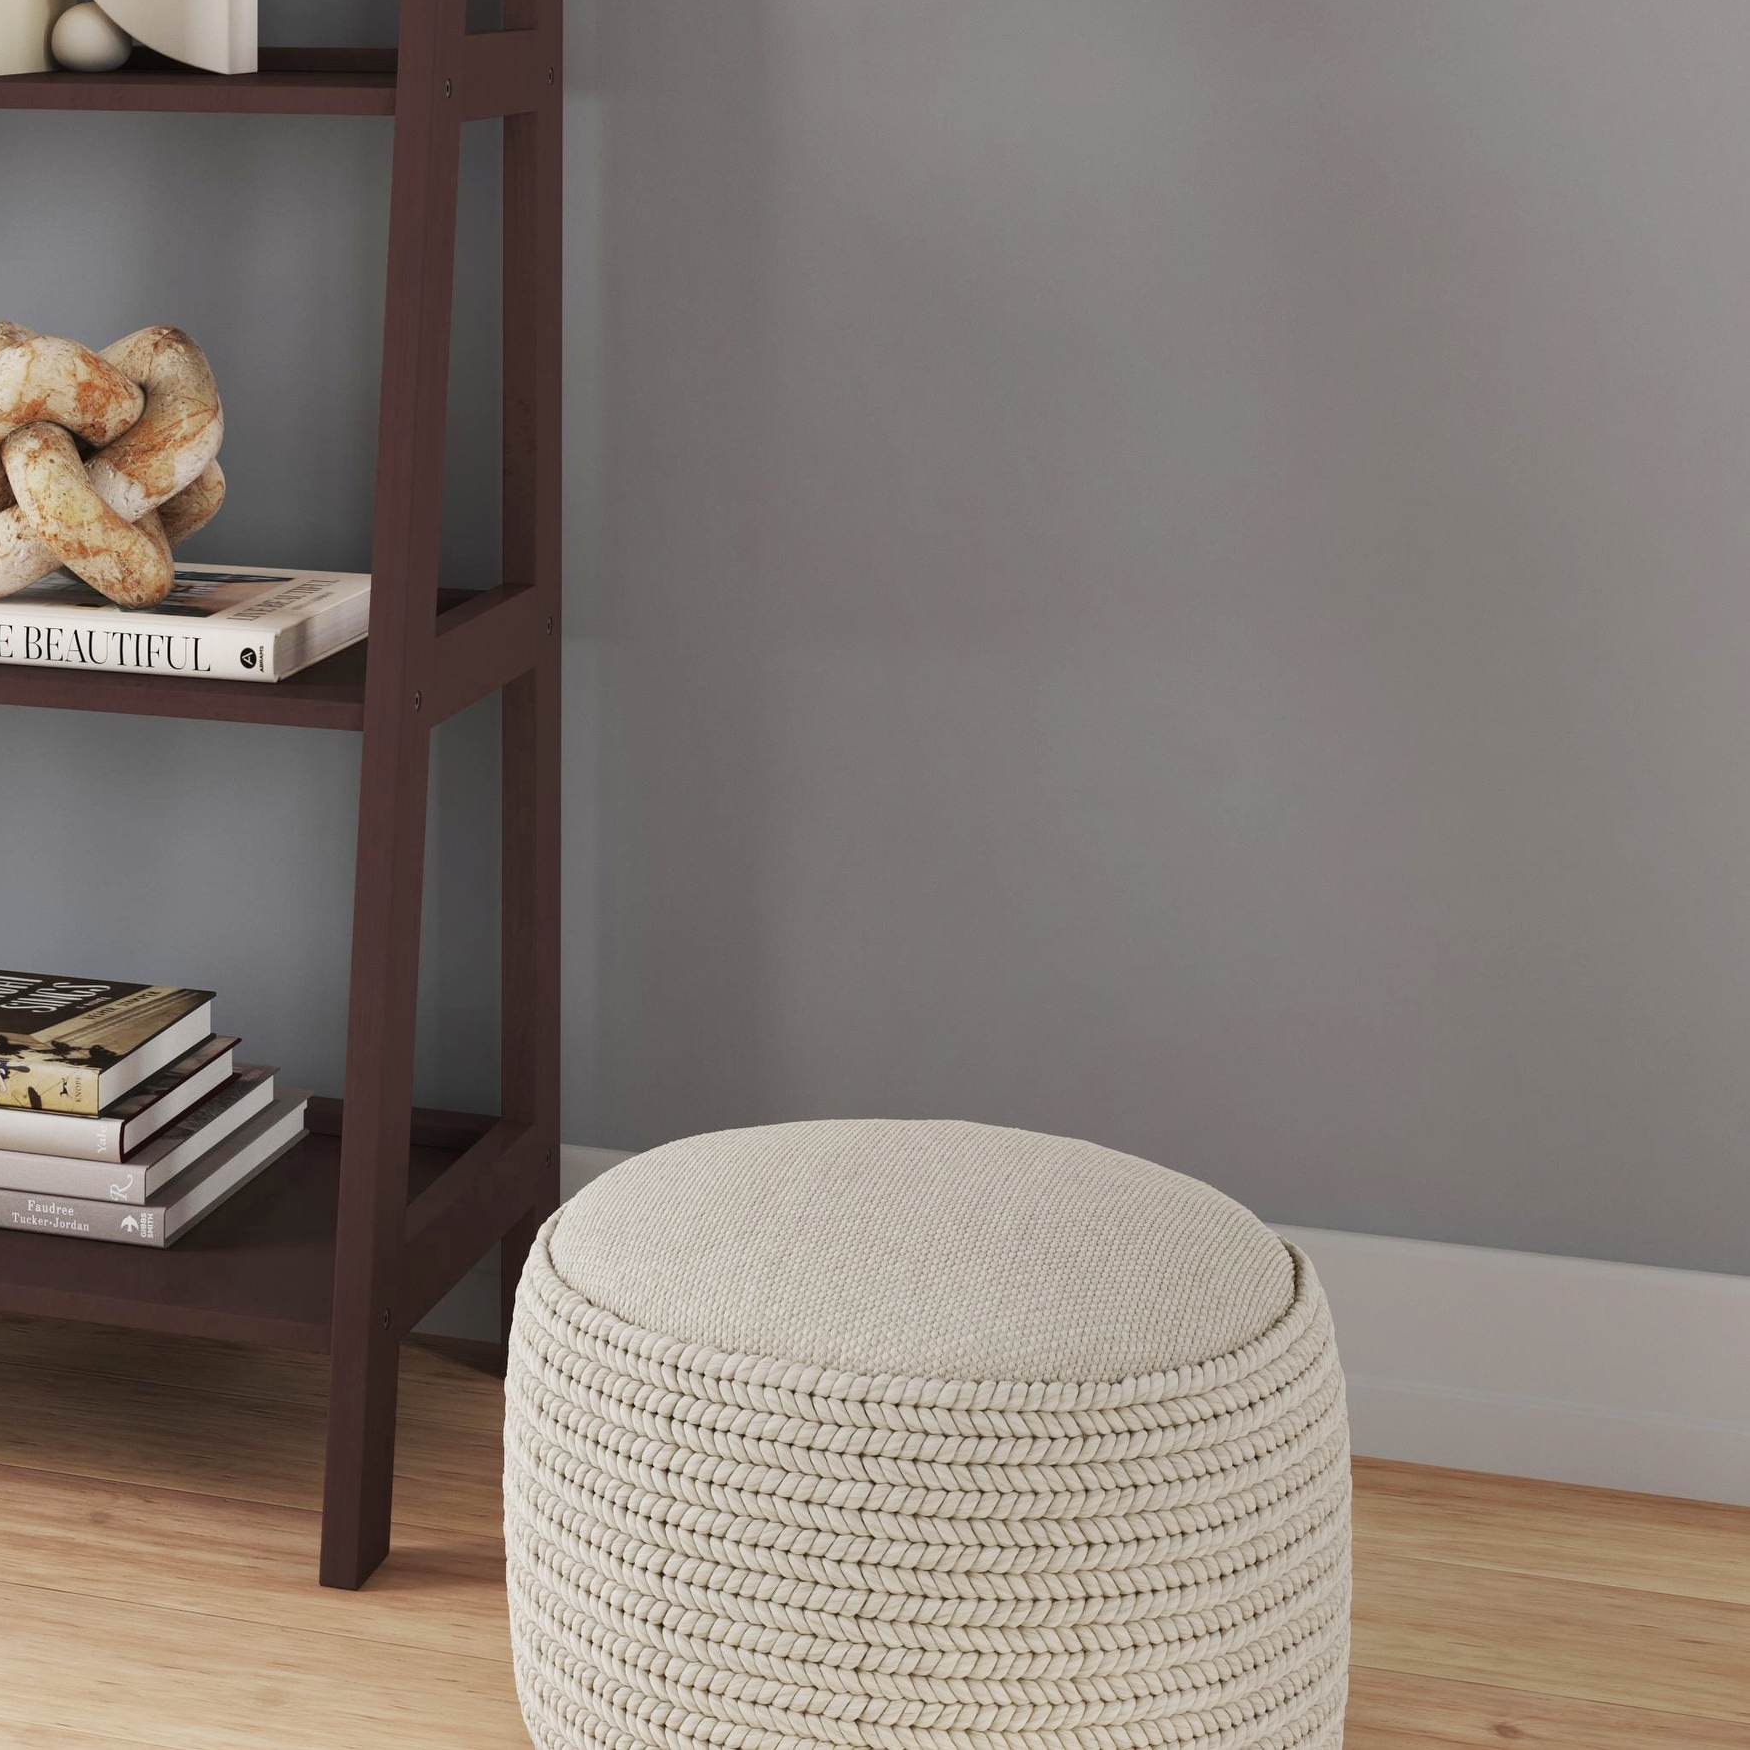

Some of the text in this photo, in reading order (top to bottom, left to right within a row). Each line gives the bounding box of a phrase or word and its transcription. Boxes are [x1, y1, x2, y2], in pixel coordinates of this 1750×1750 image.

[24, 625, 211, 673] BEAUTIFUL
[0, 982, 111, 1013] SINGS
[97, 1126, 107, 1154] Yale
[27, 1200, 74, 1216] Faudree
